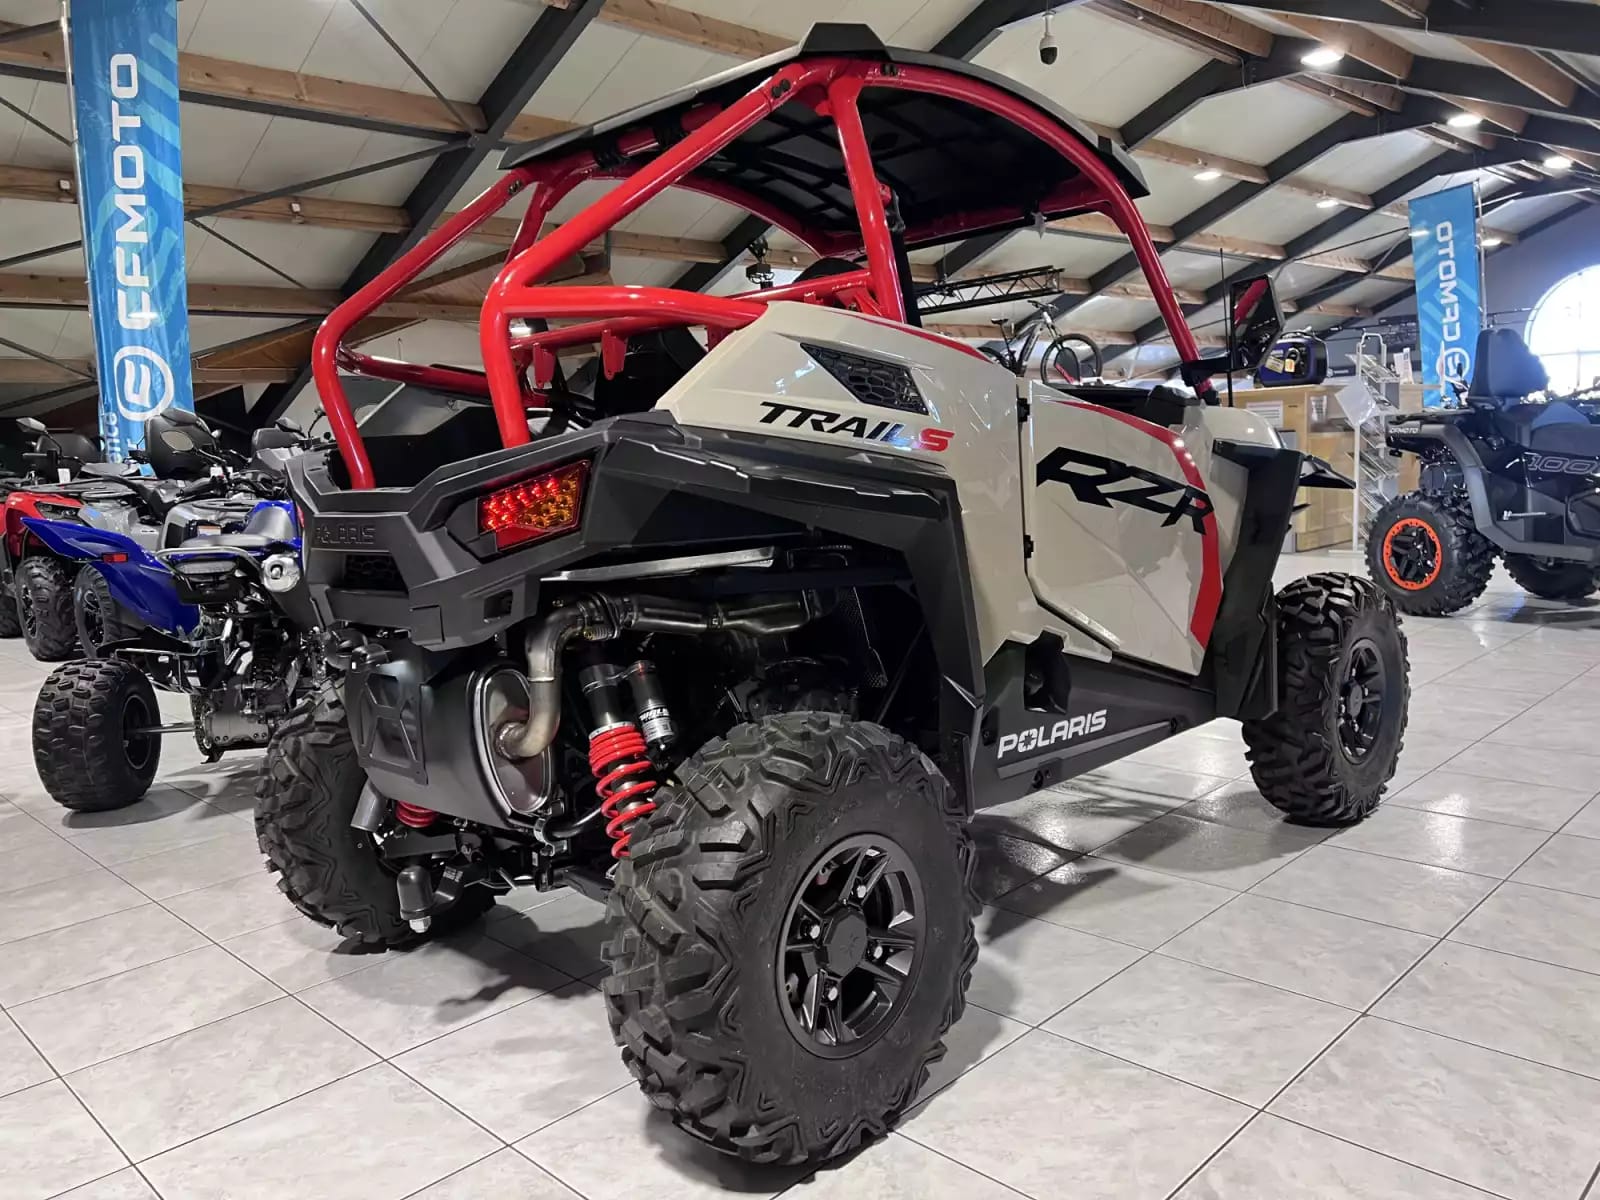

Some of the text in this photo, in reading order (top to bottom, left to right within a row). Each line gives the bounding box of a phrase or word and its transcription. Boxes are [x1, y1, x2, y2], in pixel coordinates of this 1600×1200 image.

[110, 53, 151, 330] CFMOTO
[759, 401, 956, 453] TRAILS
[1037, 446, 1213, 535] RZR
[997, 709, 1108, 760] POLARIS
